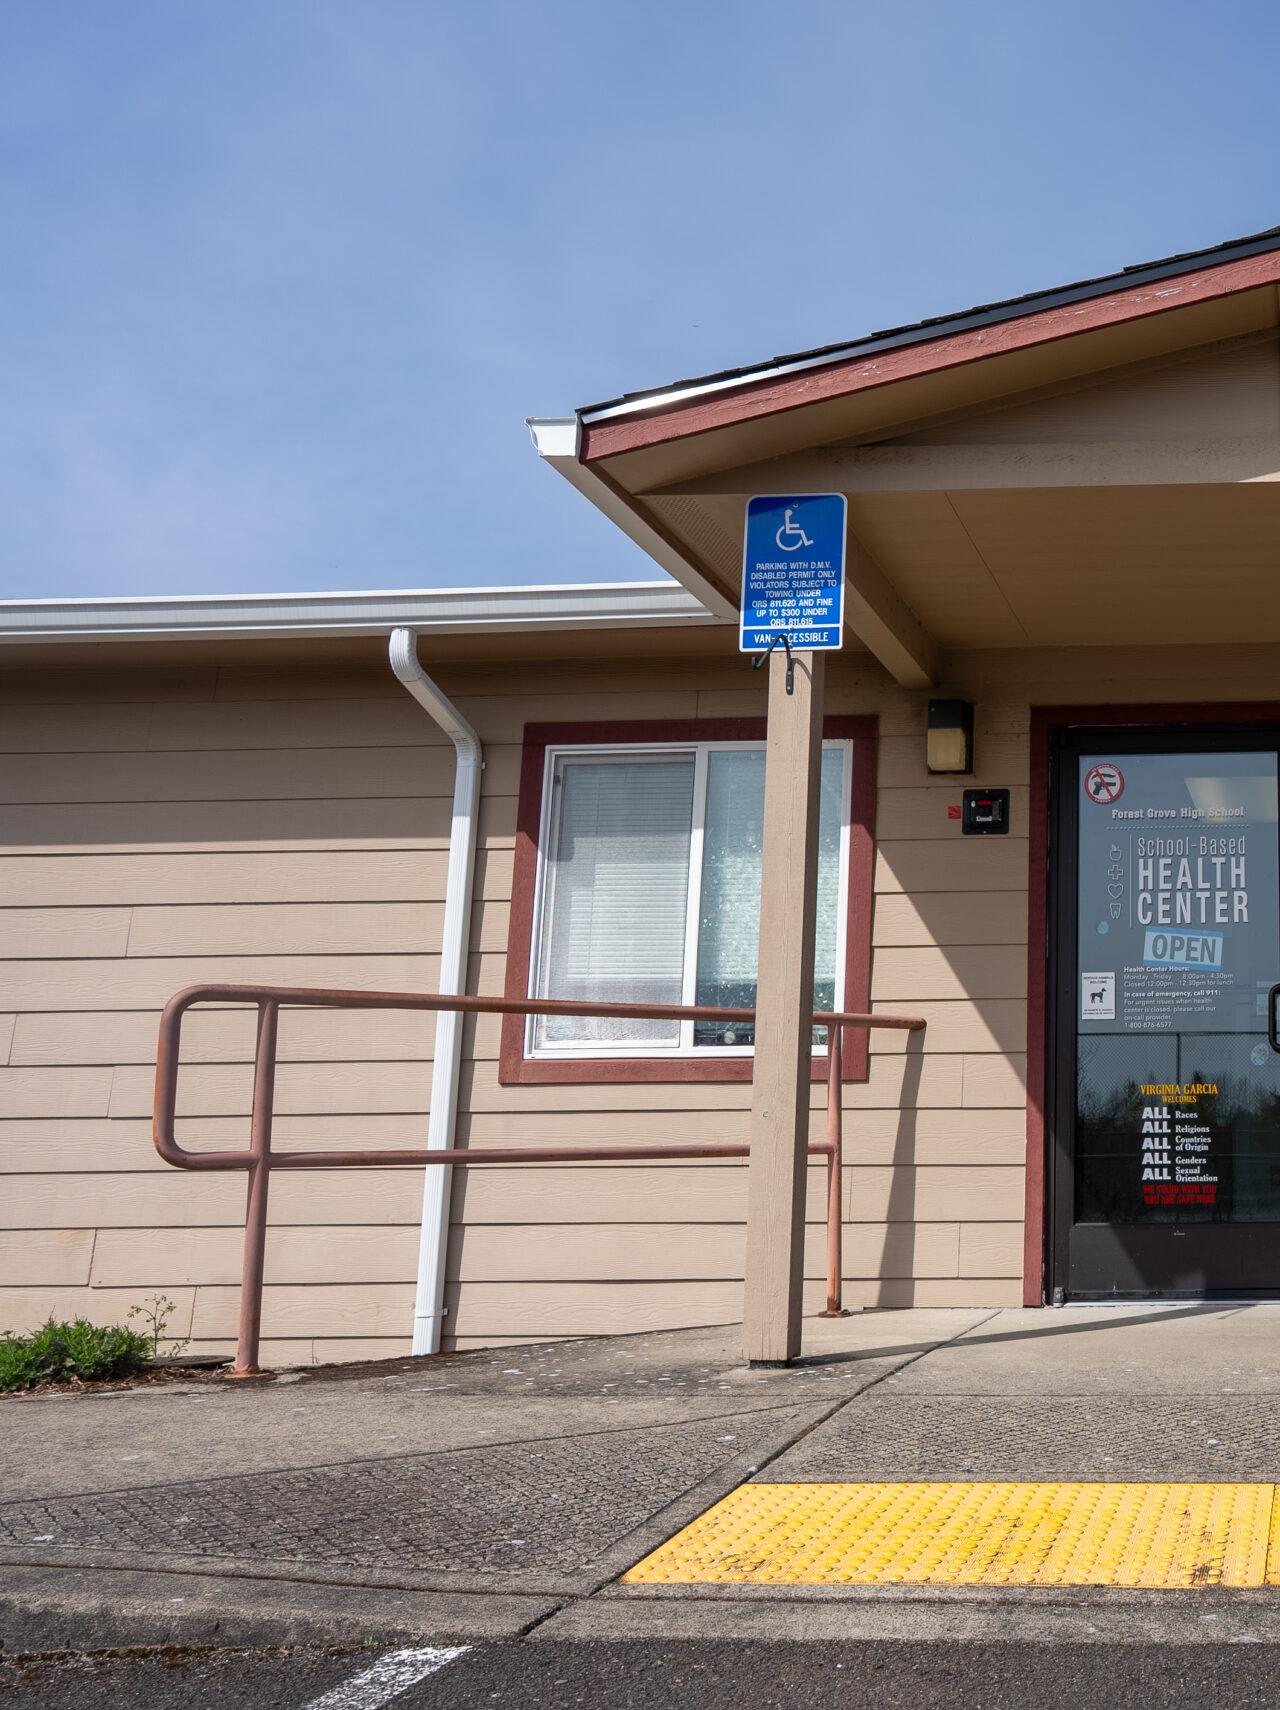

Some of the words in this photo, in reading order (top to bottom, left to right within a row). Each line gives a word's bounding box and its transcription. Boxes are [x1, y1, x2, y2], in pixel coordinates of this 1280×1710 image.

[756, 562, 788, 571] PARKING
[790, 561, 809, 570] WITH
[810, 561, 832, 569] D.M.V.
[751, 571, 787, 580] DISABLED
[788, 570, 815, 579] PERMIT
[817, 570, 836, 579] ONLY
[750, 580, 789, 590] VIOLATORS
[791, 580, 824, 589] SUBJECT
[828, 579, 838, 588] TO
[765, 590, 793, 599] TOWING
[796, 589, 821, 598] UNDER
[752, 600, 768, 609] ORS
[770, 599, 796, 608] 811.620
[798, 598, 815, 607] AND
[816, 597, 833, 606] FINE
[756, 609, 767, 618] UP
[769, 609, 779, 618] TO
[781, 608, 800, 618] $300
[802, 607, 828, 617] UNDER
[770, 618, 786, 627] ORS
[788, 617, 814, 626] 811.615
[754, 631, 829, 644] VAN-CESSIBLE
[1111, 808, 1144, 819] Forest
[1147, 807, 1177, 818] Grove
[1180, 807, 1205, 819] High
[1208, 805, 1244, 817] School
[1138, 835, 1246, 857] School-Based
[1138, 856, 1246, 890] HEALTH
[1137, 890, 1249, 925] CENTER
[1151, 934, 1217, 963] OPEN
[1124, 973, 1149, 981] Monday
[1153, 972, 1172, 981] Friday
[1124, 980, 1146, 988] Closed
[1216, 978, 1234, 986] lunch
[1173, 1005, 1193, 1014] please
[1140, 1083, 1181, 1095] VIRGINIA
[1183, 1083, 1218, 1095] GARCIA
[1142, 1107, 1171, 1119] ALL
[1175, 1110, 1198, 1119] Races
[1142, 1121, 1171, 1134] ALL
[1175, 1125, 1210, 1134] Religions
[1142, 1137, 1171, 1150] ALL
[1175, 1135, 1212, 1143] Countries
[1175, 1143, 1183, 1151] of
[1185, 1143, 1209, 1152] Origin
[1142, 1152, 1171, 1165] ALL
[1175, 1156, 1206, 1164] Genders
[1142, 1168, 1171, 1181] ALL
[1175, 1166, 1201, 1174] Sexual
[1176, 1174, 1218, 1183] Orientation
